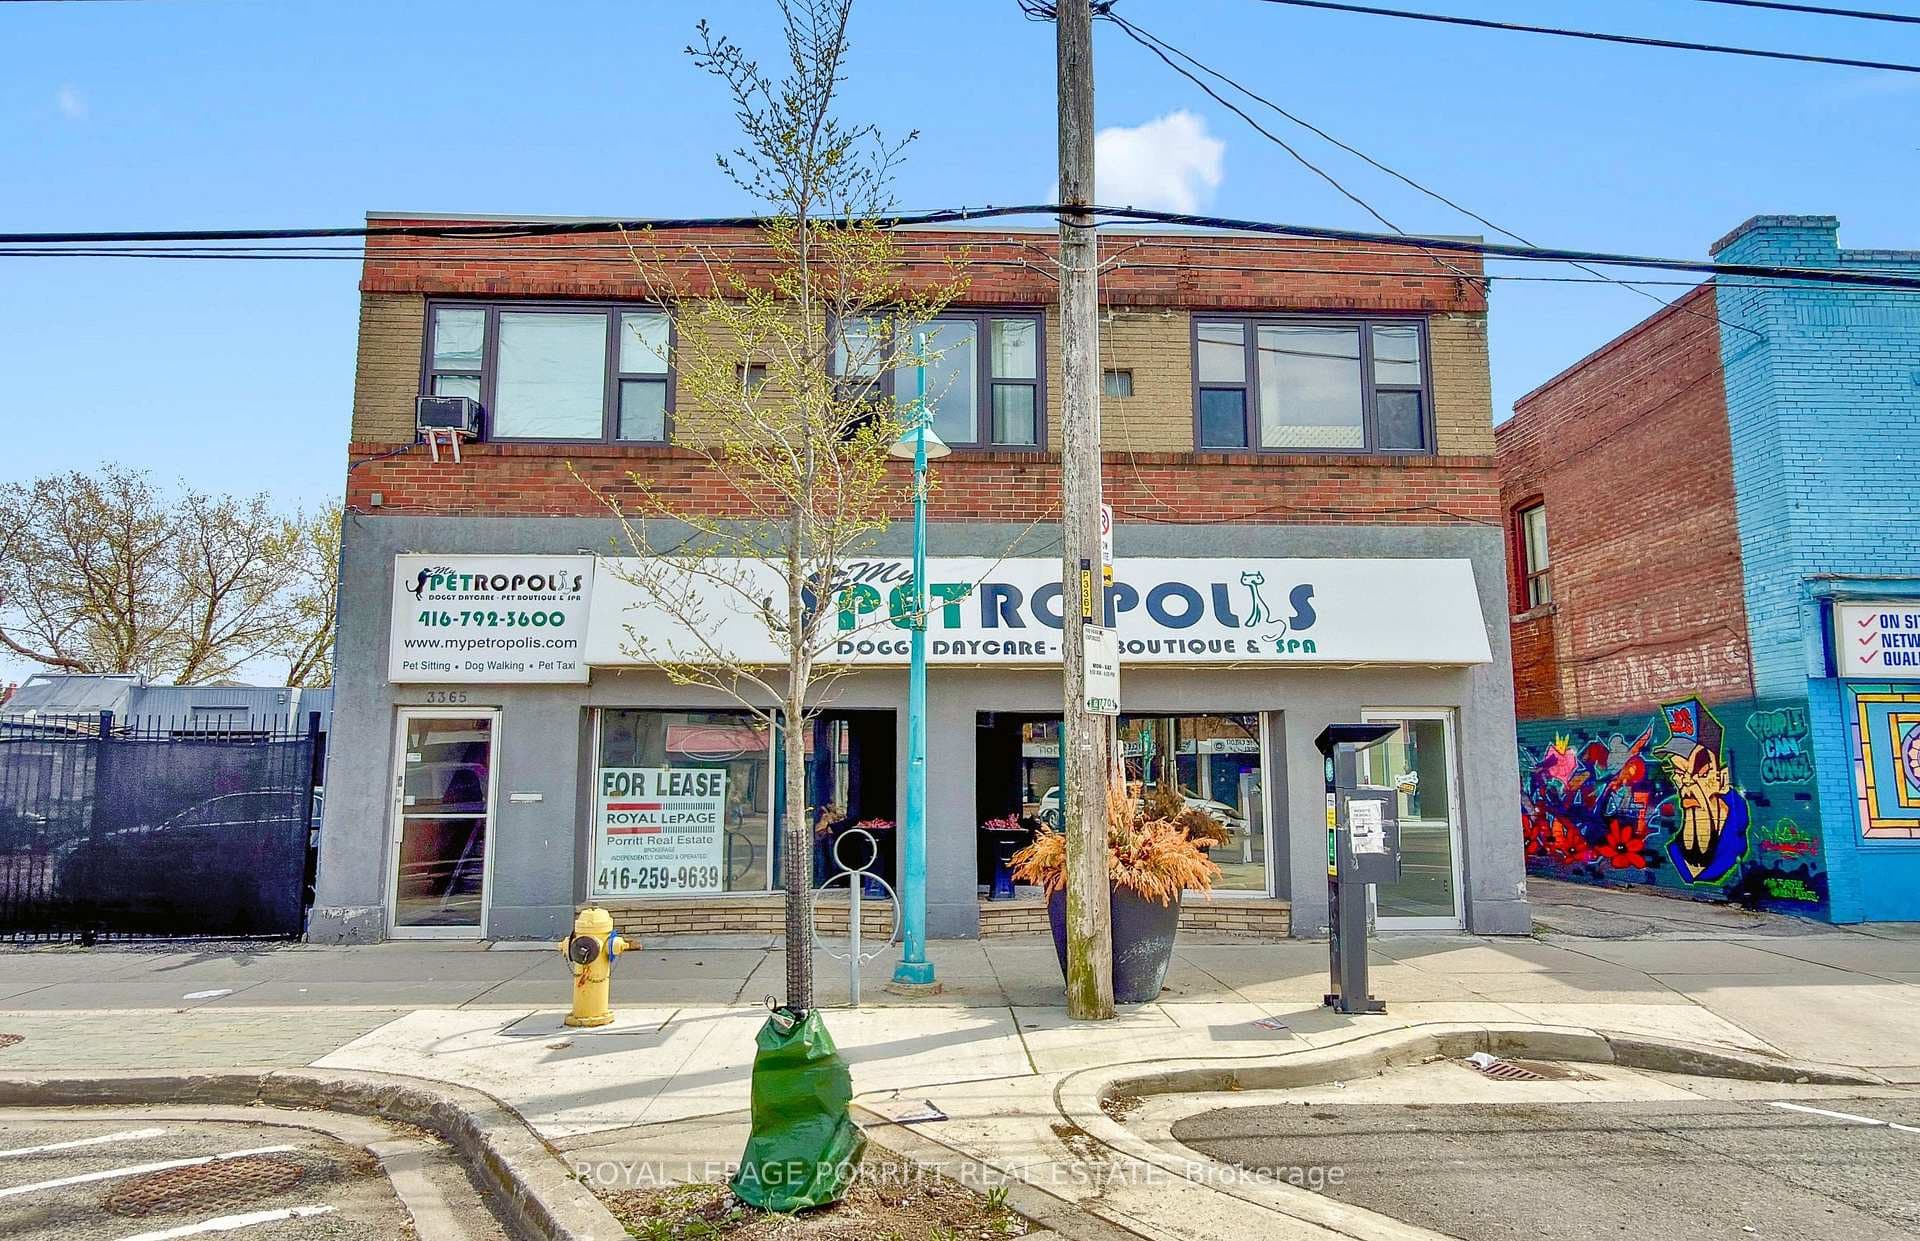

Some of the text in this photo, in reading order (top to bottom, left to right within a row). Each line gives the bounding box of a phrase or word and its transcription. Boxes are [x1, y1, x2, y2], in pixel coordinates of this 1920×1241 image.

[432, 566, 456, 576] My
[430, 573, 582, 593] PETROPOLIS
[1082, 571, 1090, 616] P3367
[418, 611, 566, 627] 416-792-3600
[1880, 614, 1920, 629] ON SI
[404, 637, 577, 651] www.mypetropolis.com
[837, 640, 913, 655] DOGG
[1246, 639, 1260, 653] &
[1276, 638, 1317, 653] SPA
[1881, 633, 1920, 648] NETW
[1883, 651, 1920, 666] QUAL
[403, 660, 576, 673] Pet Sitting Dog Walking Pet Taxi
[427, 691, 467, 703] 3365
[1764, 736, 1799, 757] CAN
[603, 772, 721, 797] FOR LEASE
[607, 813, 716, 824] ROYAL LePAGE
[607, 835, 713, 846] Porritt Real Estate
[599, 866, 719, 889] 416-259-9639
